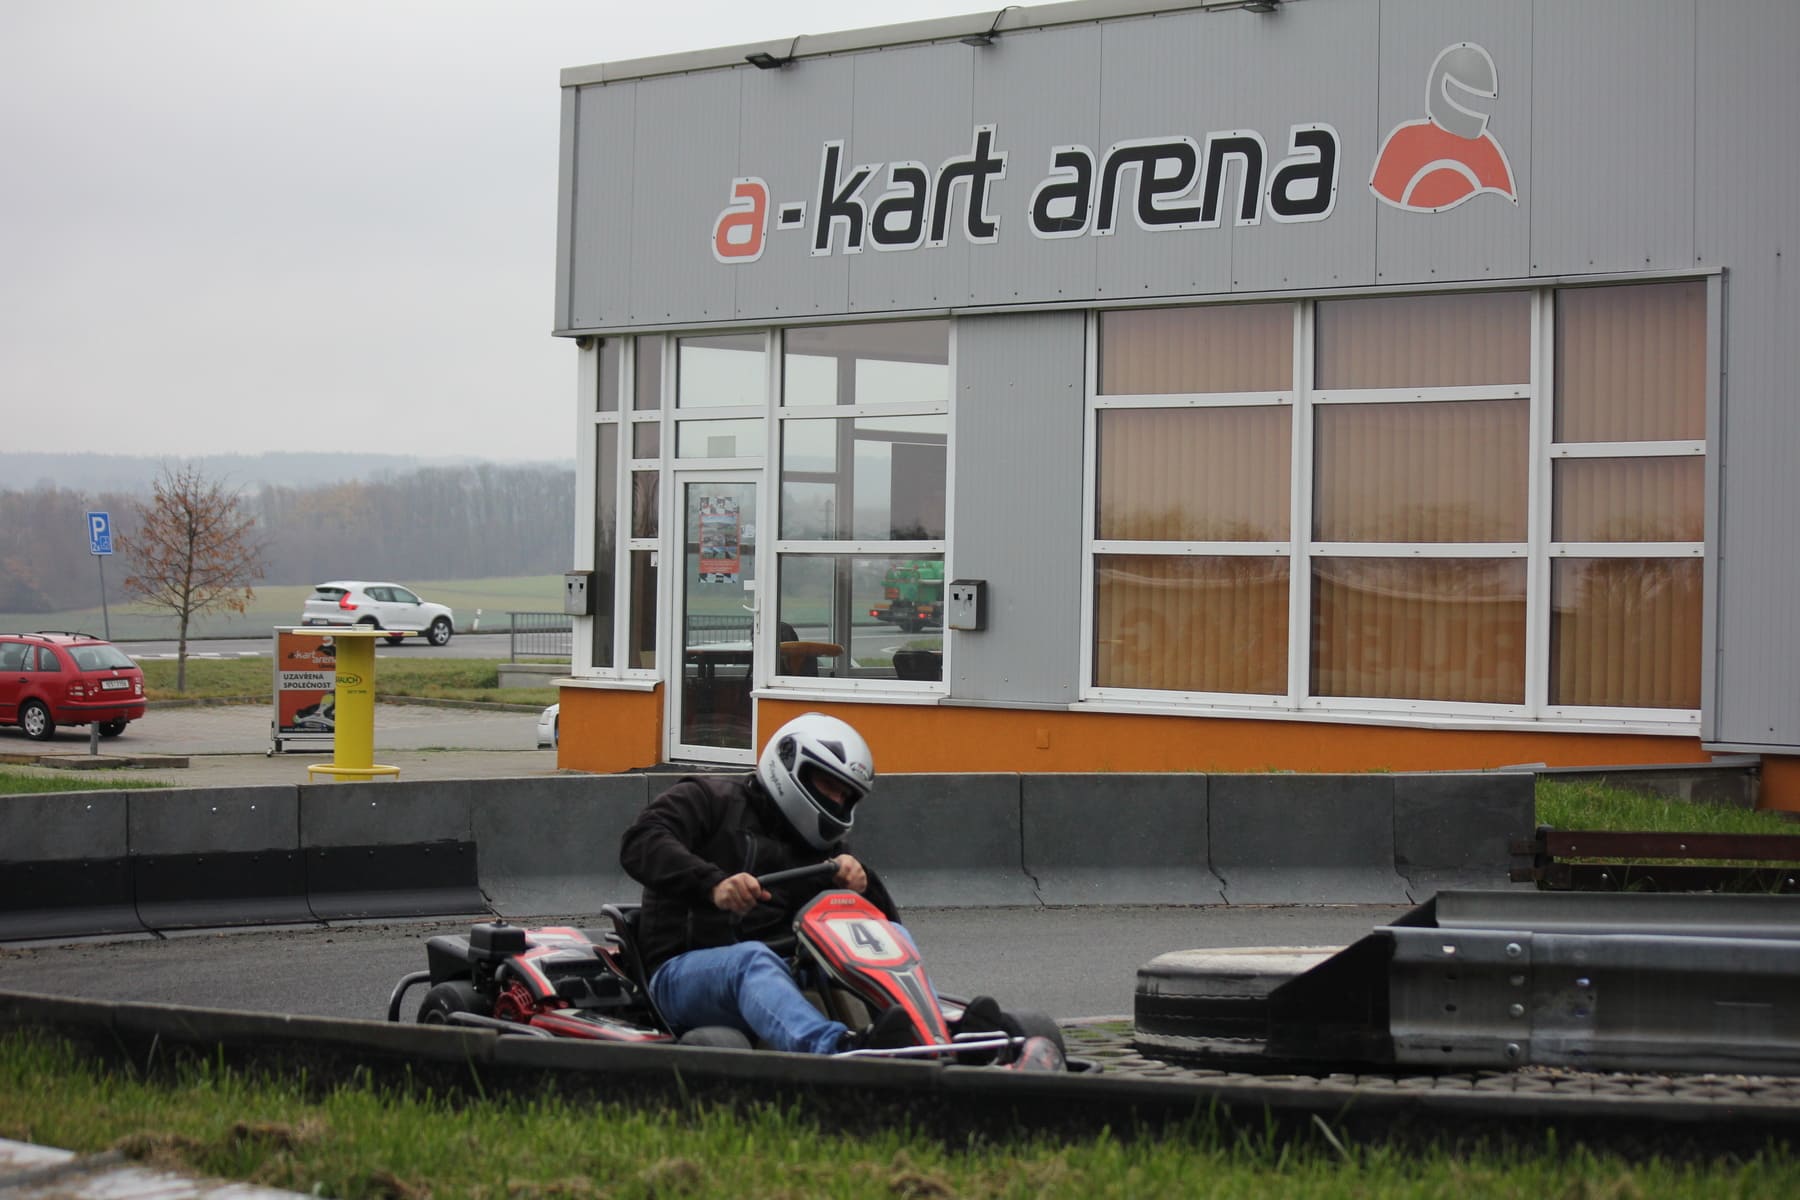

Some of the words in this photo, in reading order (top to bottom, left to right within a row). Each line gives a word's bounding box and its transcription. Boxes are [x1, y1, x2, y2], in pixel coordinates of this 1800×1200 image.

[713, 126, 1006, 261] a-kart
[1030, 125, 1339, 237] arena
[92, 516, 106, 541] P
[283, 672, 325, 680] UZAVŘENA
[283, 681, 331, 689] SPOLEČNOST
[849, 922, 885, 954] 4
